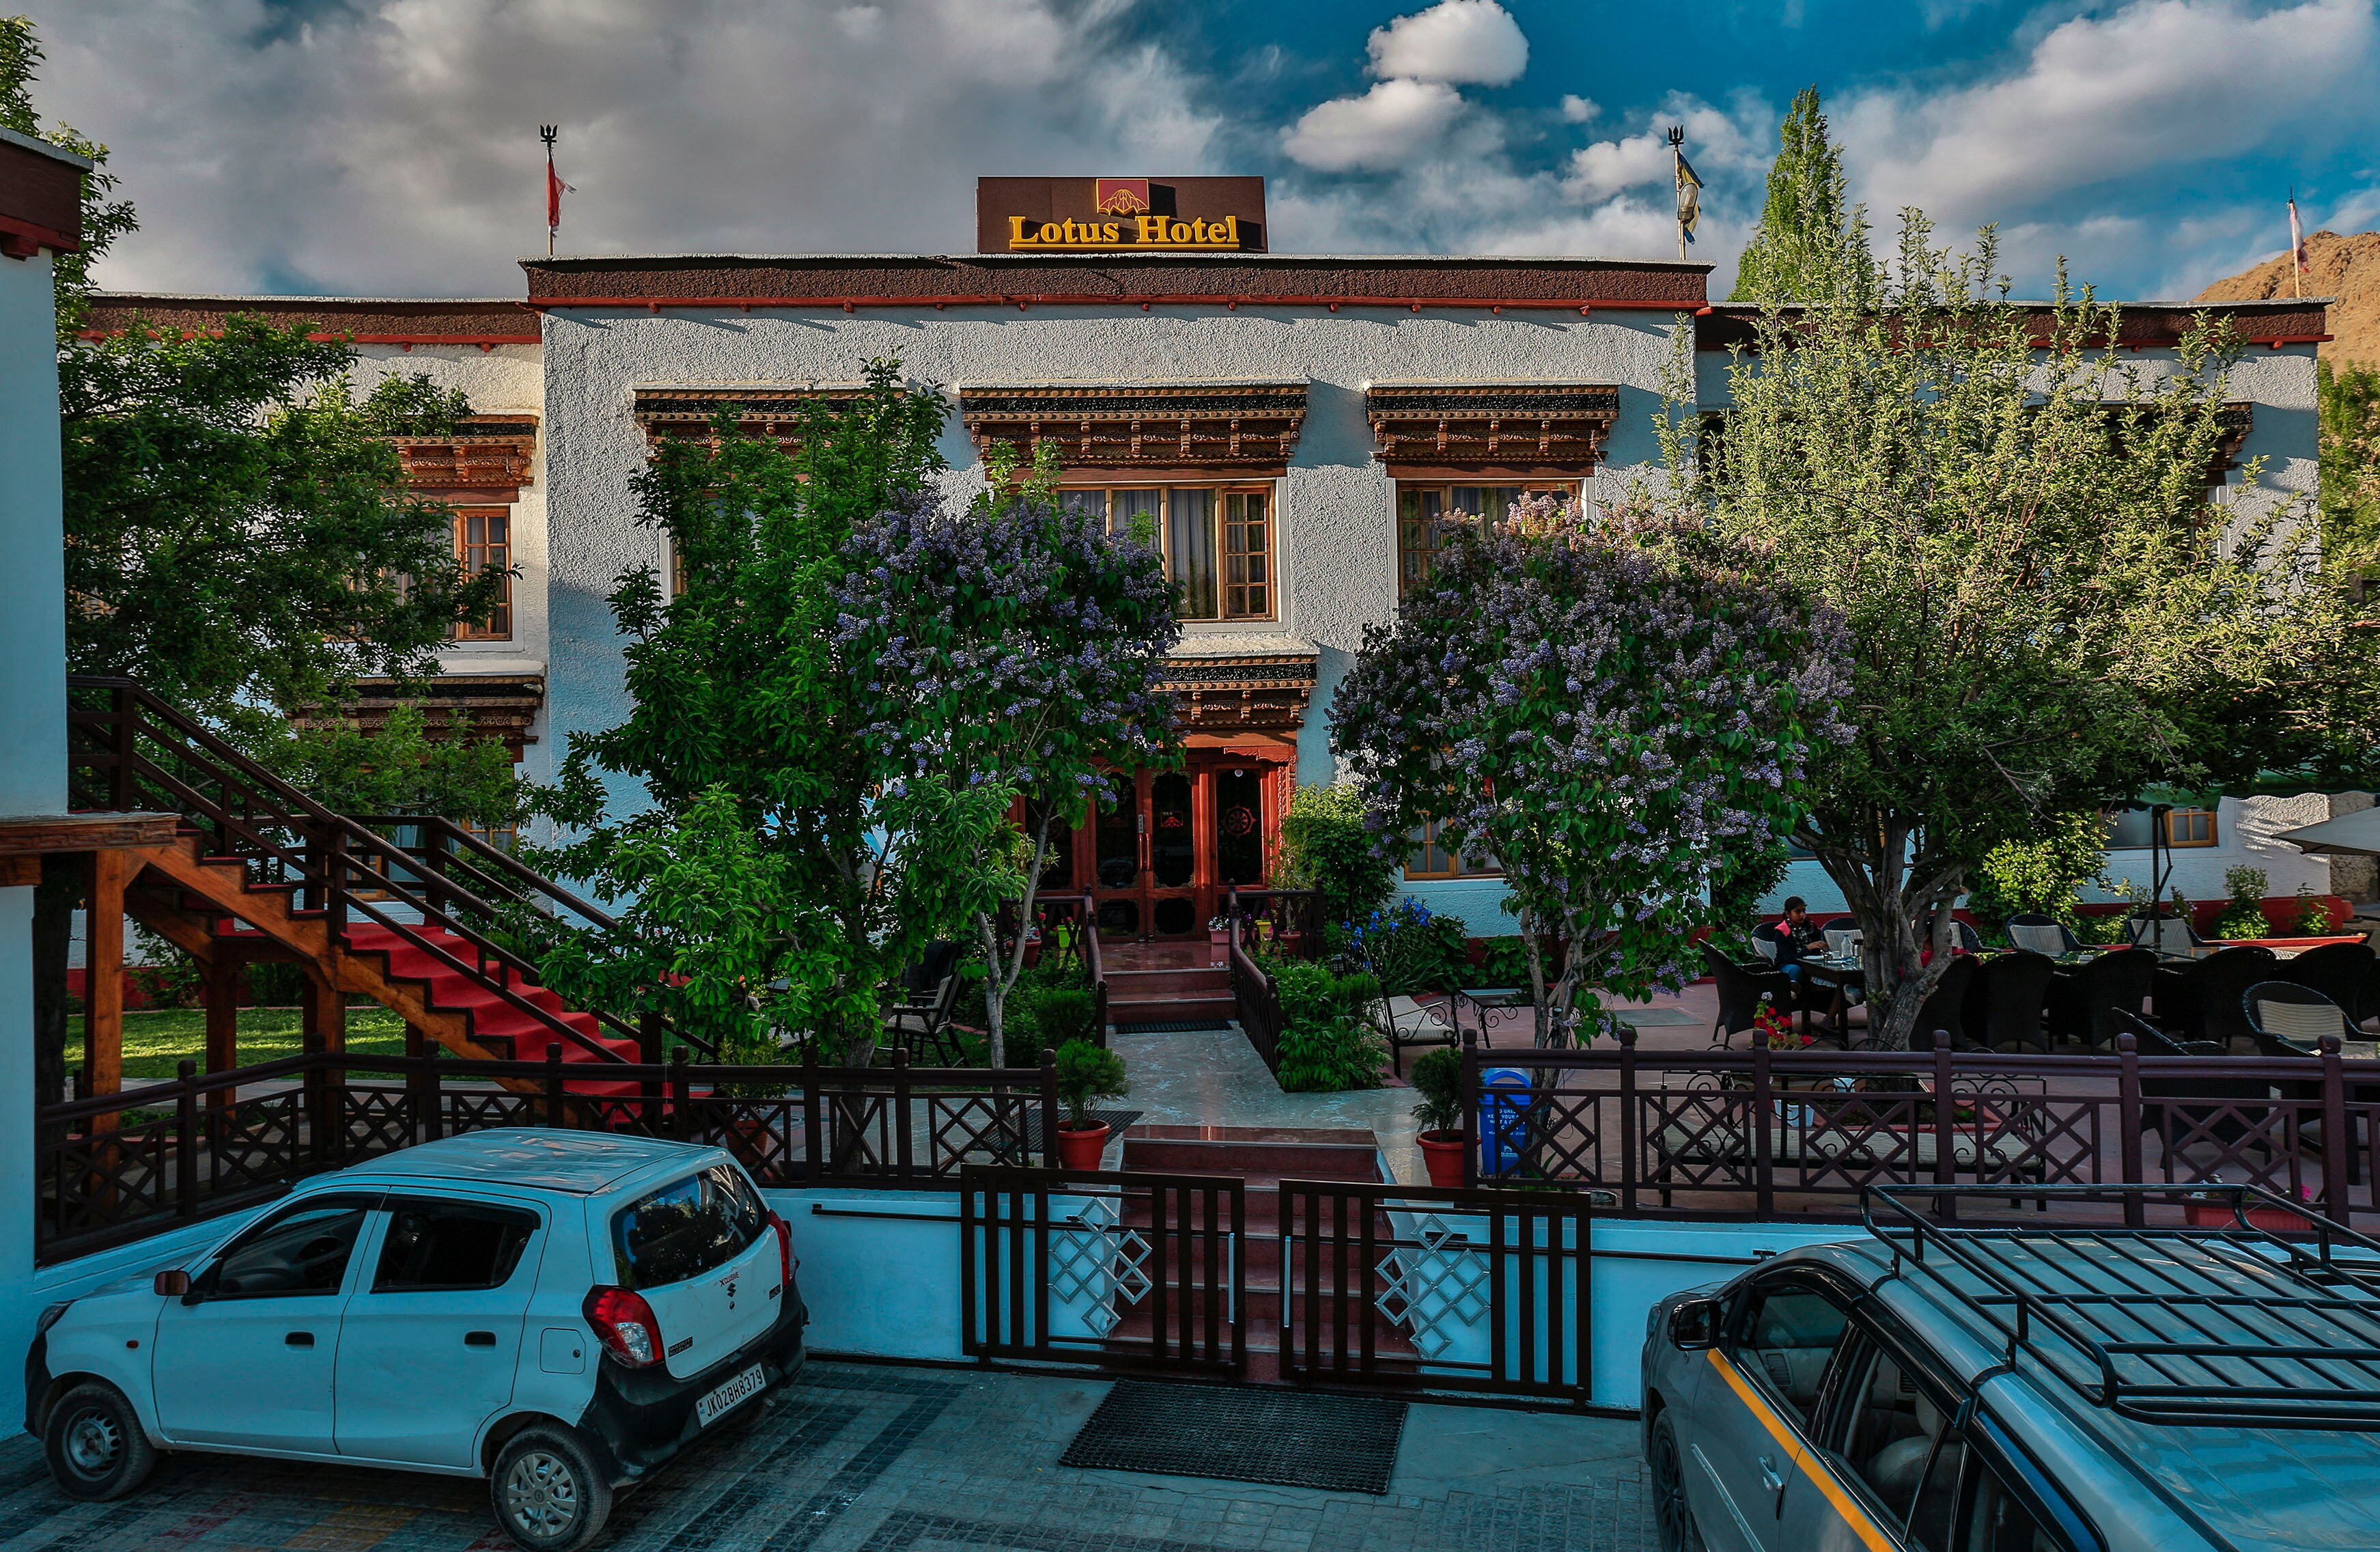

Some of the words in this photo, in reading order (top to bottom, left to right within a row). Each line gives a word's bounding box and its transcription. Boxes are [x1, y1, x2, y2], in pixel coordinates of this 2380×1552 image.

[1009, 215, 1119, 244] Lotus
[1134, 215, 1240, 244] Hotel
[707, 1370, 763, 1417] JK02BH8379
